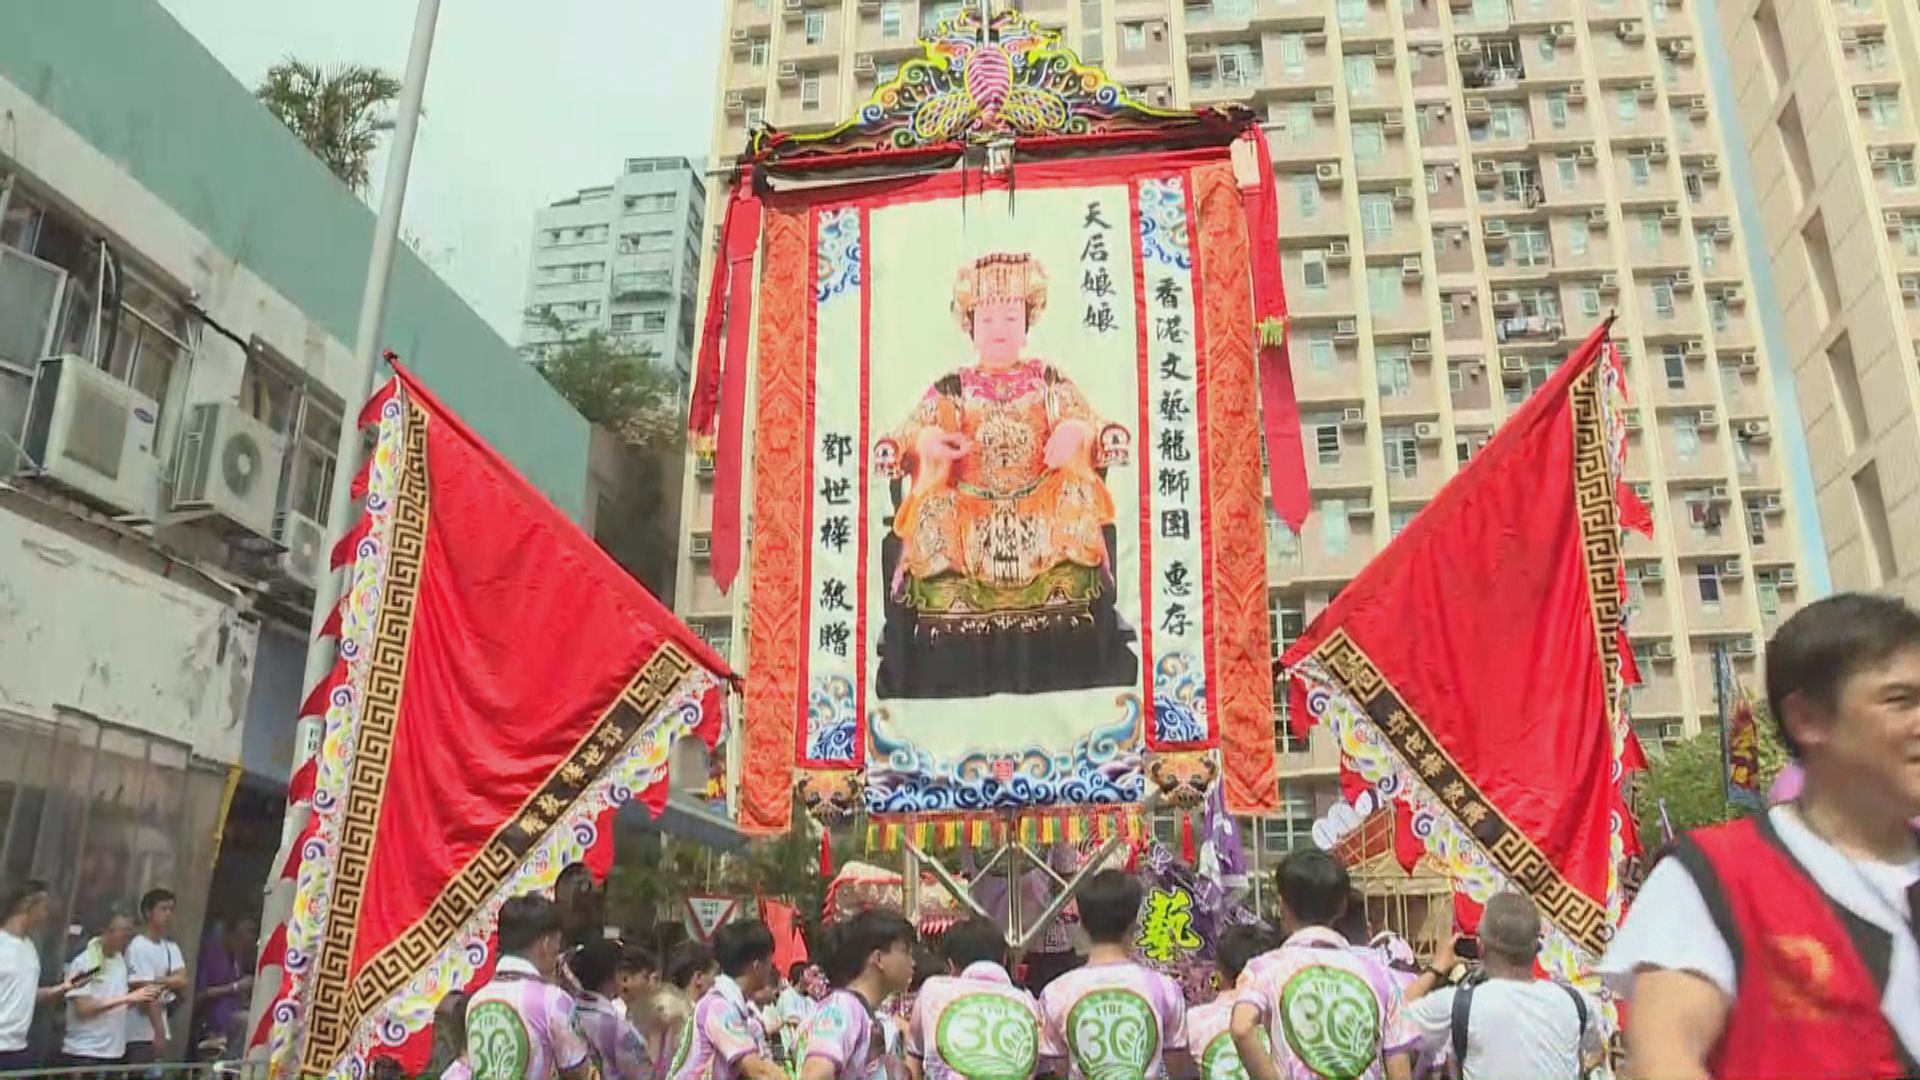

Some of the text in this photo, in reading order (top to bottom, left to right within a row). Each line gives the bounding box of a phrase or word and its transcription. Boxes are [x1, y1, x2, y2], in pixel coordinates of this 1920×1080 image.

[1080, 200, 1119, 333] 天后娘娘
[818, 432, 853, 657] 鄧世樺 敬贈
[1155, 277, 1193, 637] 香港文藝龍獅團 惠存
